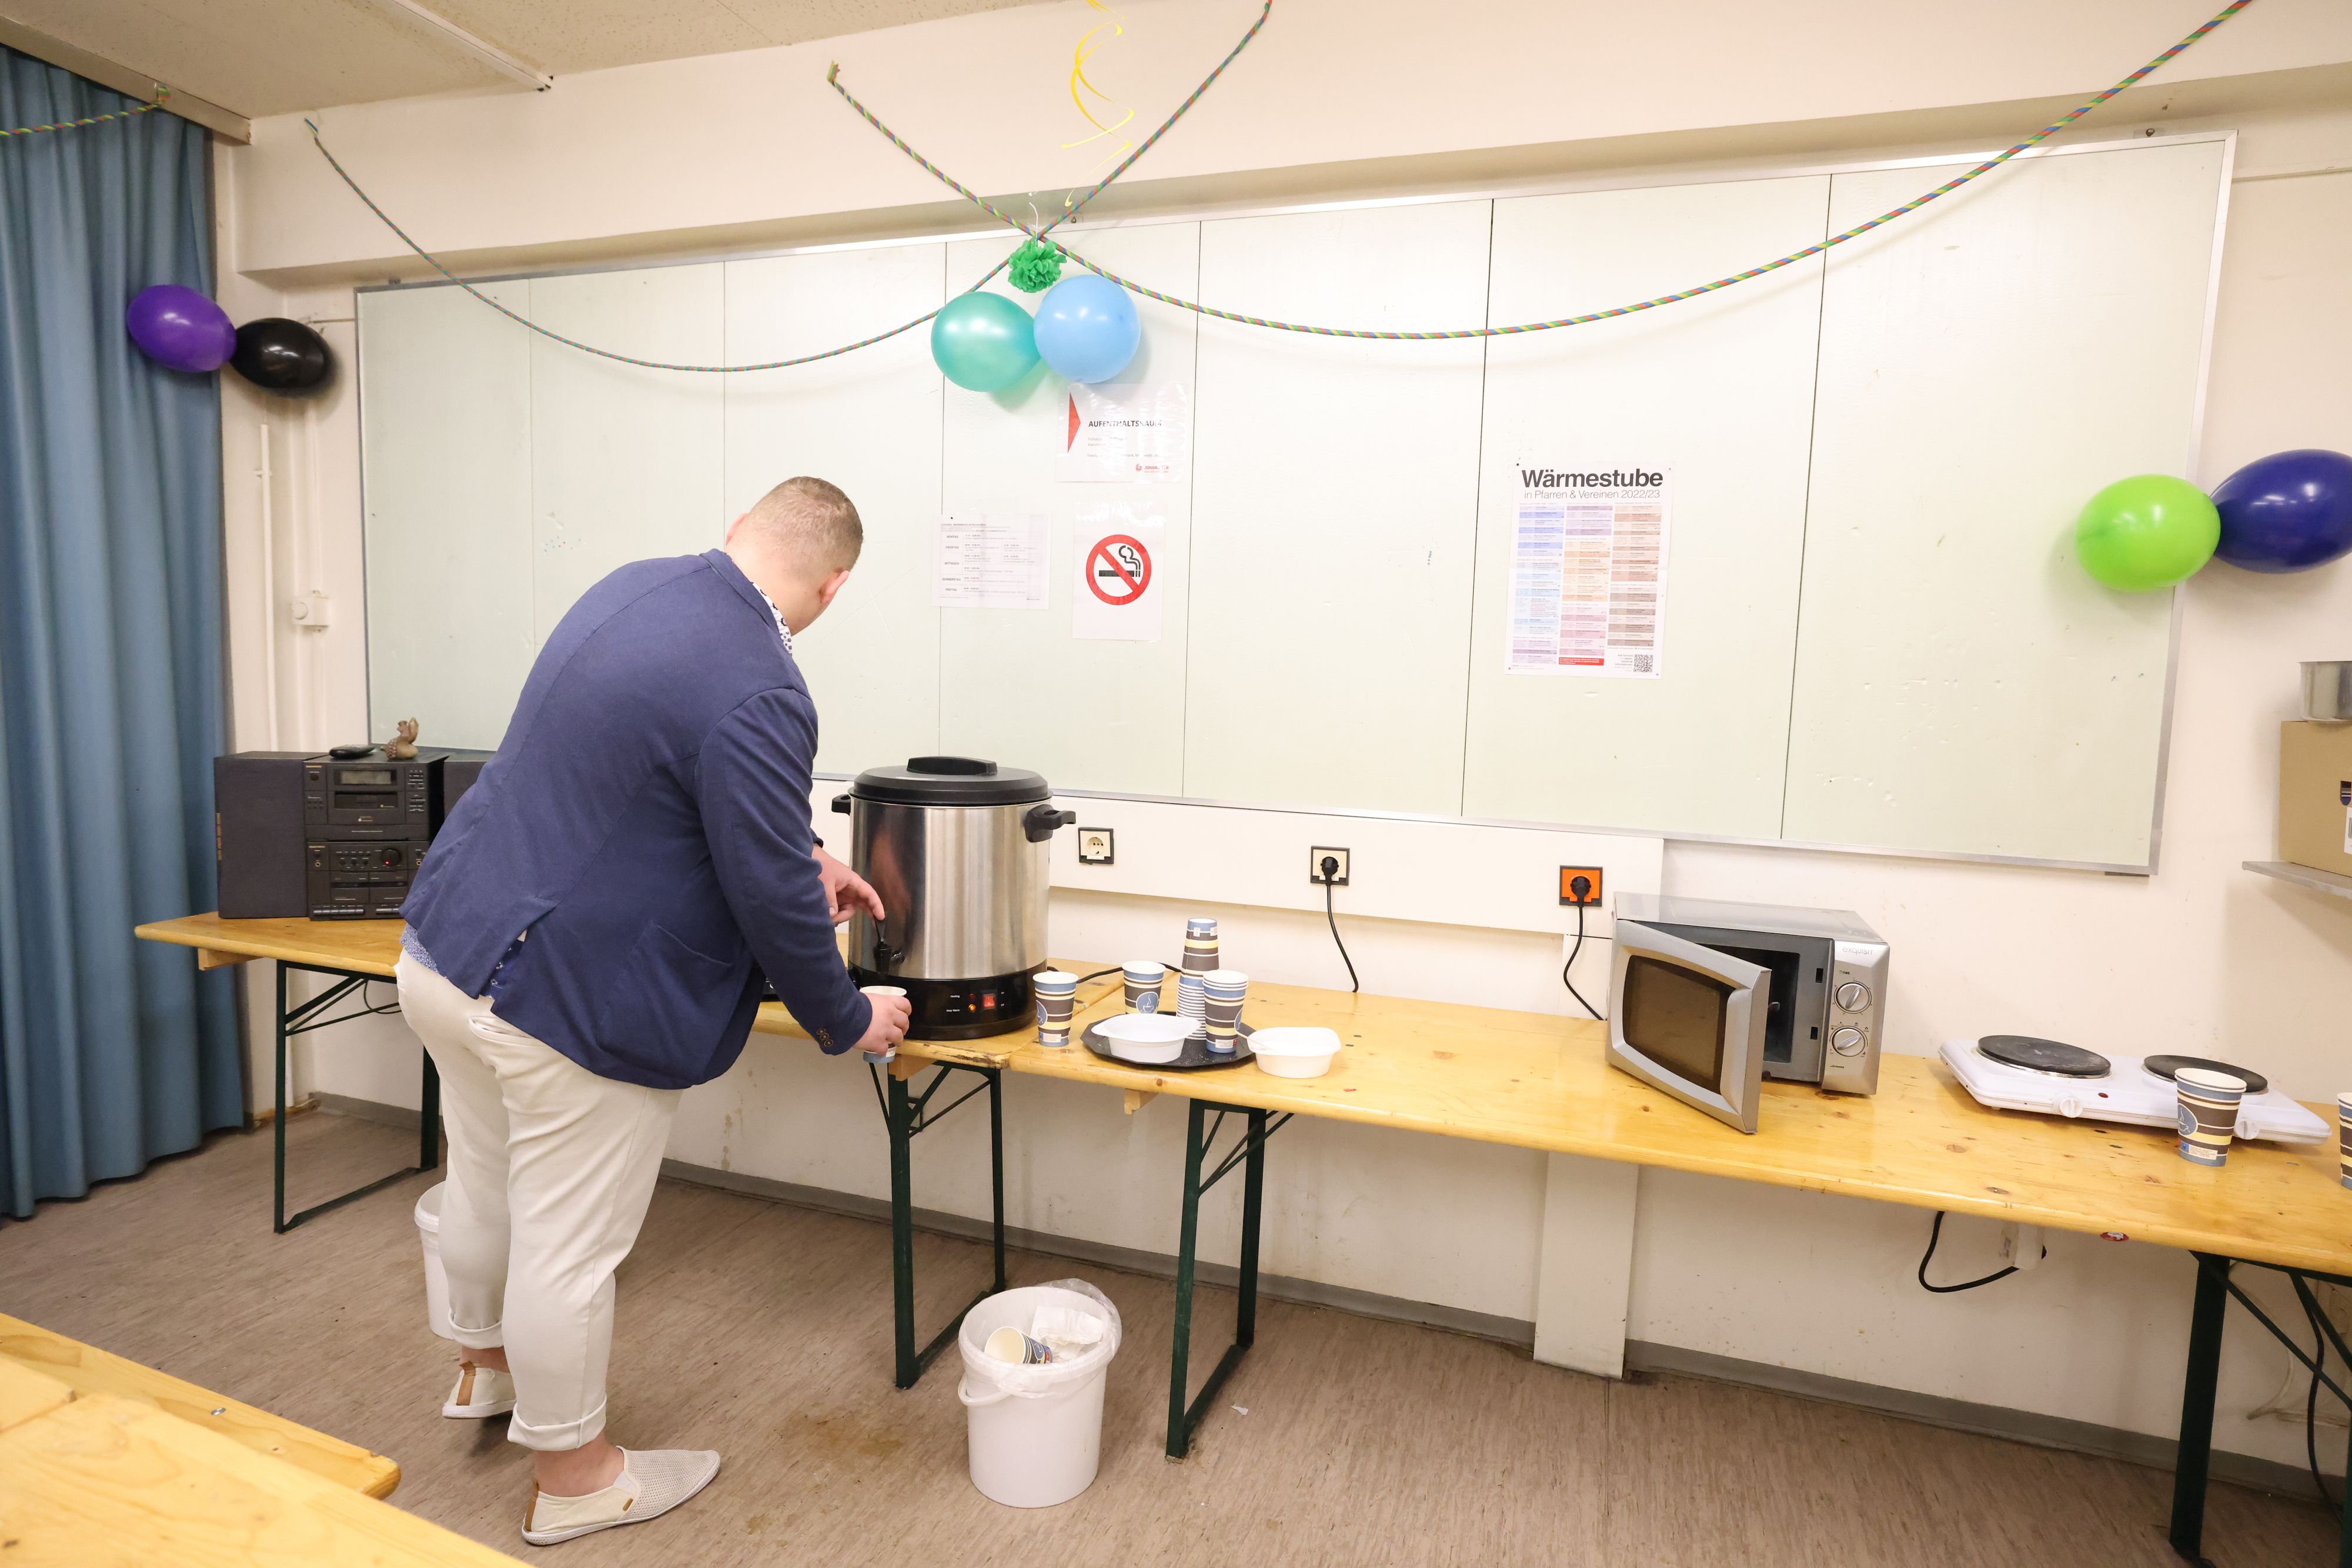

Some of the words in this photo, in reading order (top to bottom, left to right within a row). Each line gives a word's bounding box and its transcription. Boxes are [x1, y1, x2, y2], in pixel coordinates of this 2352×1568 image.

[1522, 469, 1663, 487] Wärmestube
[1524, 490, 1532, 499] in
[1535, 490, 1567, 499] Pfarren
[1569, 490, 1576, 499] &
[1578, 490, 1619, 499] Vereinen
[1621, 489, 1660, 499] 2022/23
